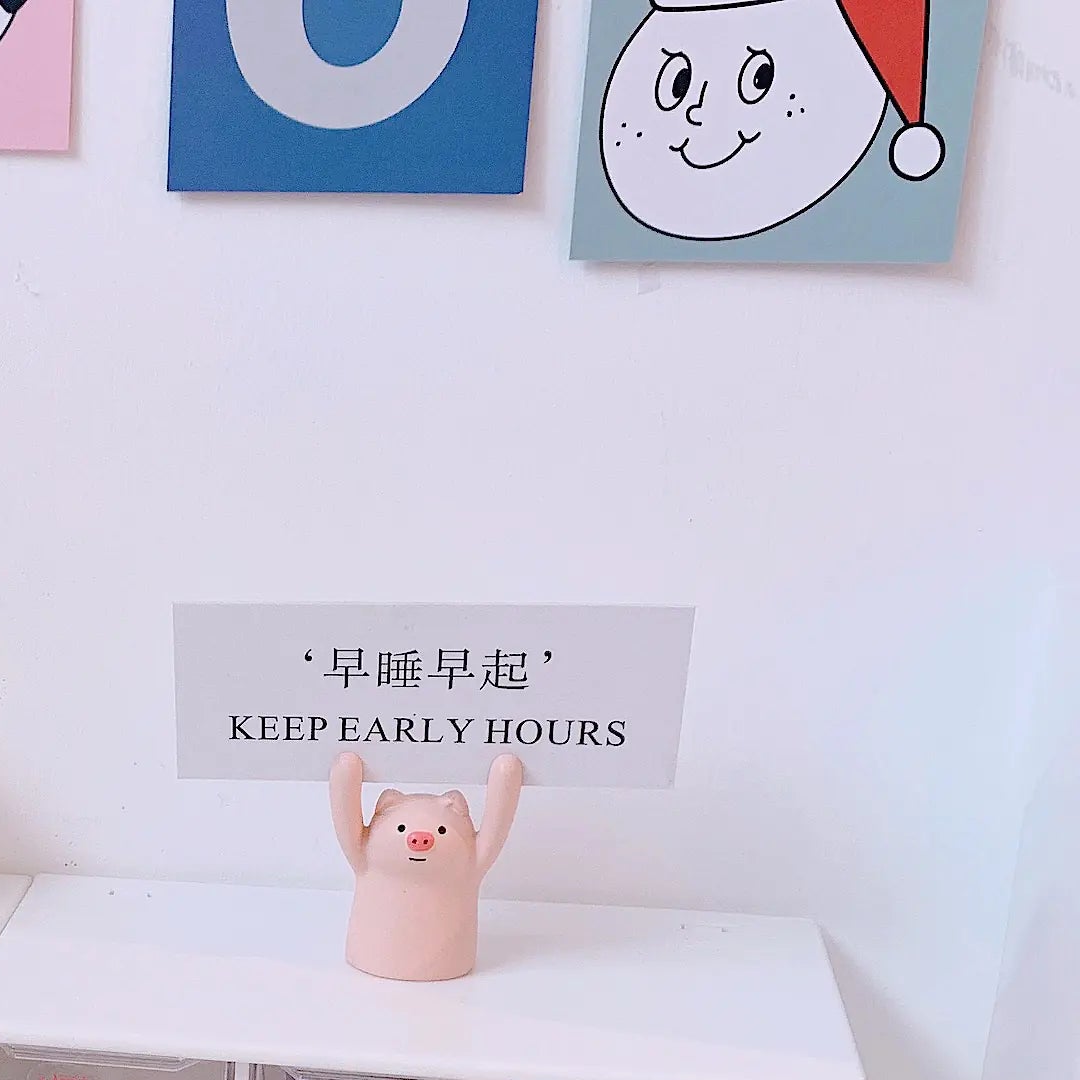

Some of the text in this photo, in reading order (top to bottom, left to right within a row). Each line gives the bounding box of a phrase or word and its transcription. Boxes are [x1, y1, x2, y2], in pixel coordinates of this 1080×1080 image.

[229, 714, 626, 747] KEEP EARLY HOURS
